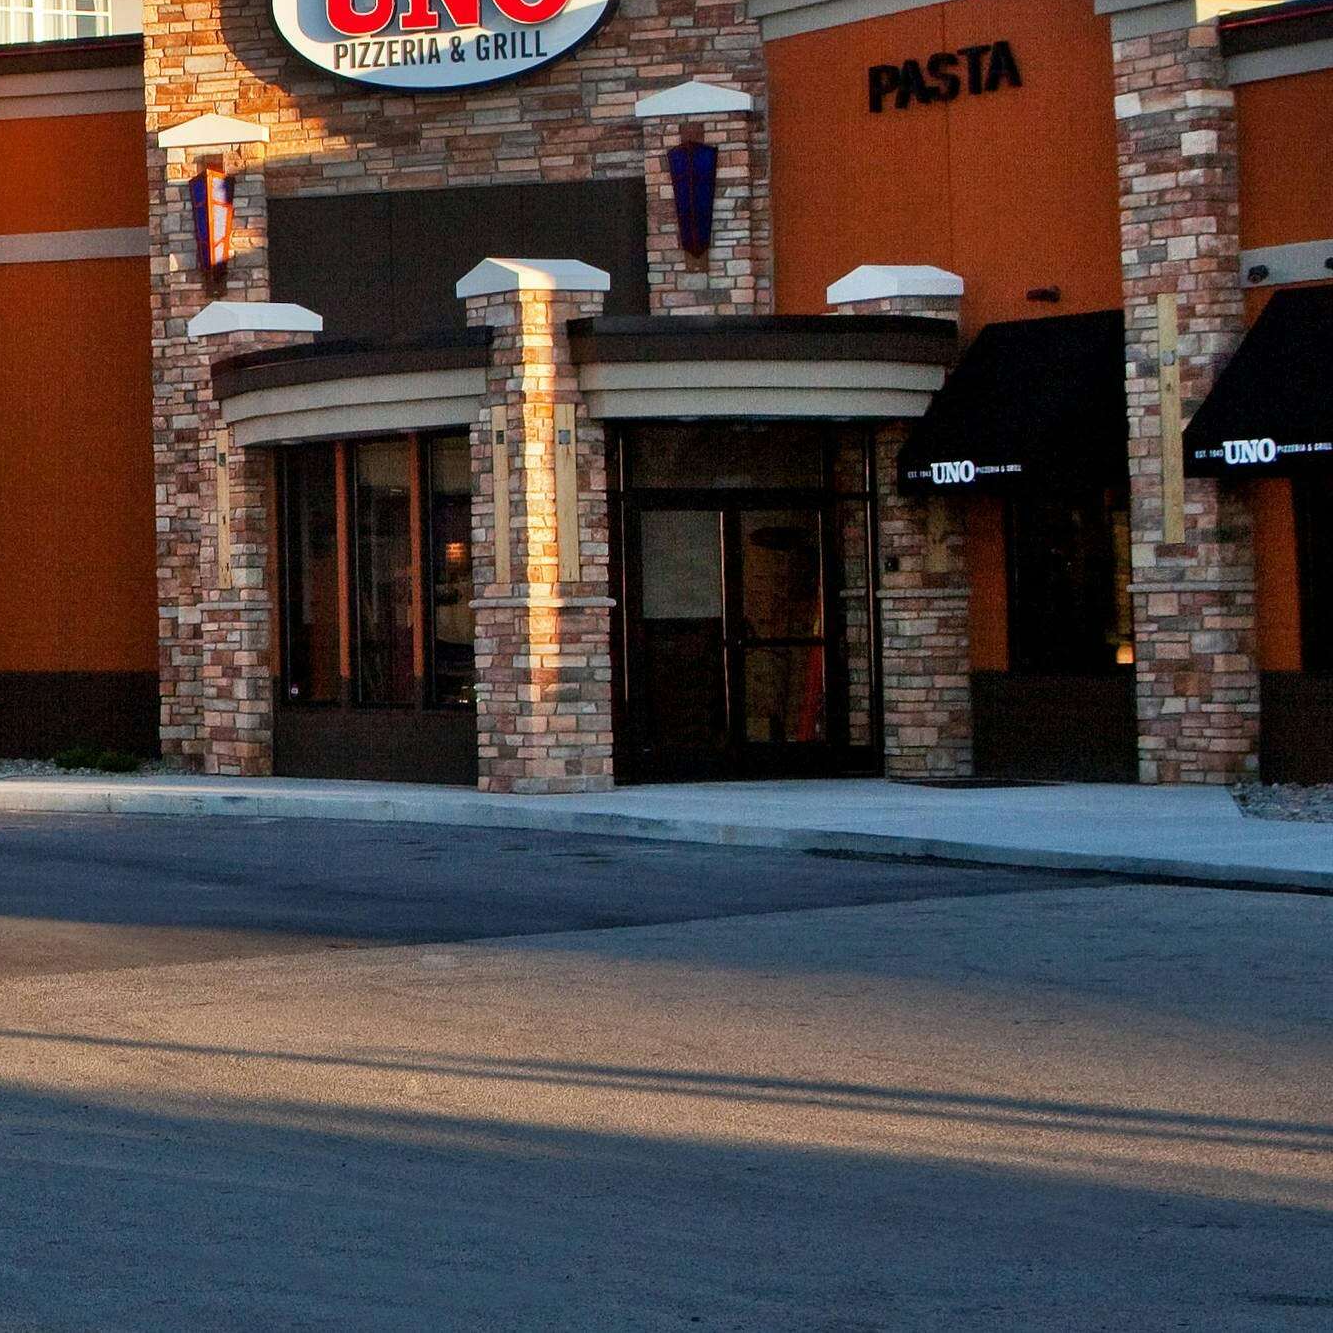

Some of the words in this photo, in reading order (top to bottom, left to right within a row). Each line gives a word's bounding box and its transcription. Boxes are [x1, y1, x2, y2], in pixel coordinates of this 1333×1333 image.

[334, 37, 441, 70] PIZZERIA
[450, 36, 465, 63] &
[476, 30, 547, 59] GRILL
[869, 41, 1023, 113] PASTA
